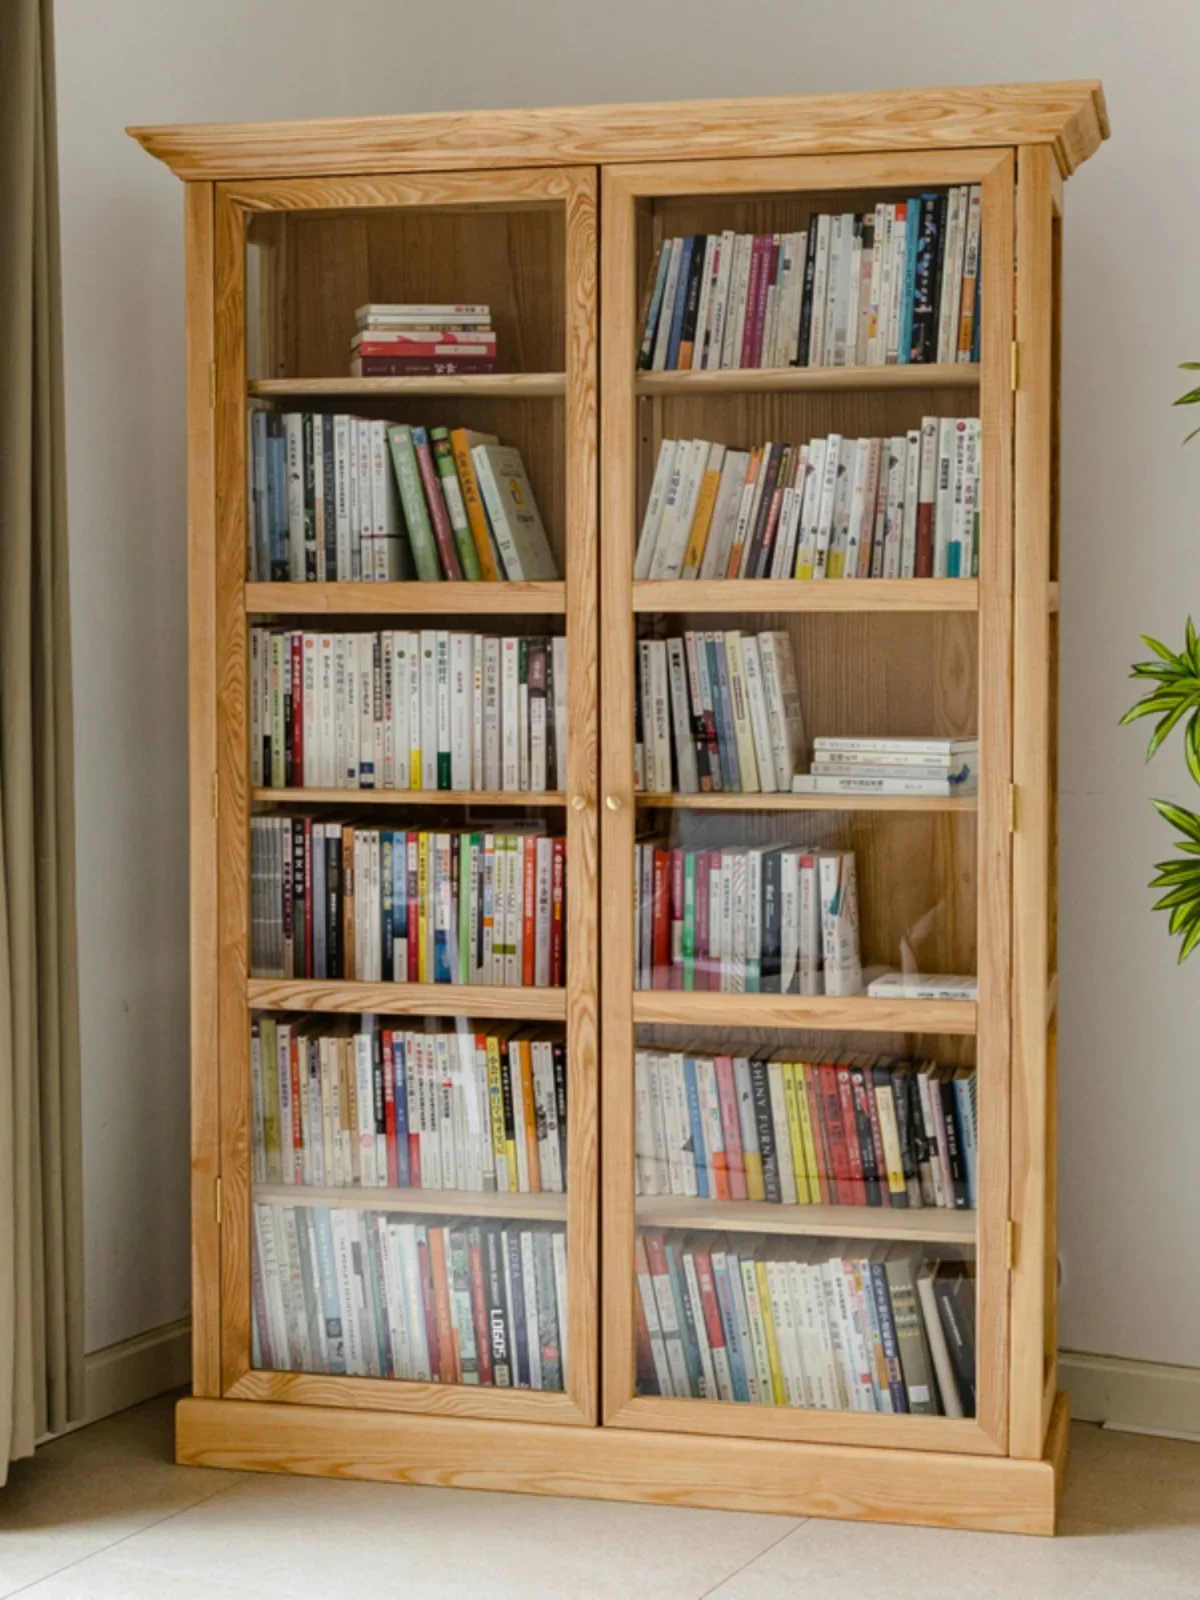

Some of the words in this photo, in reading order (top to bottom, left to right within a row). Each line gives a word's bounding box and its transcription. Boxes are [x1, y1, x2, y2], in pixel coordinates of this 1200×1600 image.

[752, 1061, 766, 1106] SHINY
[758, 1116, 777, 1201] FURNITURE
[509, 1239, 520, 1279] FLORA
[490, 1309, 506, 1359] LOGOS
